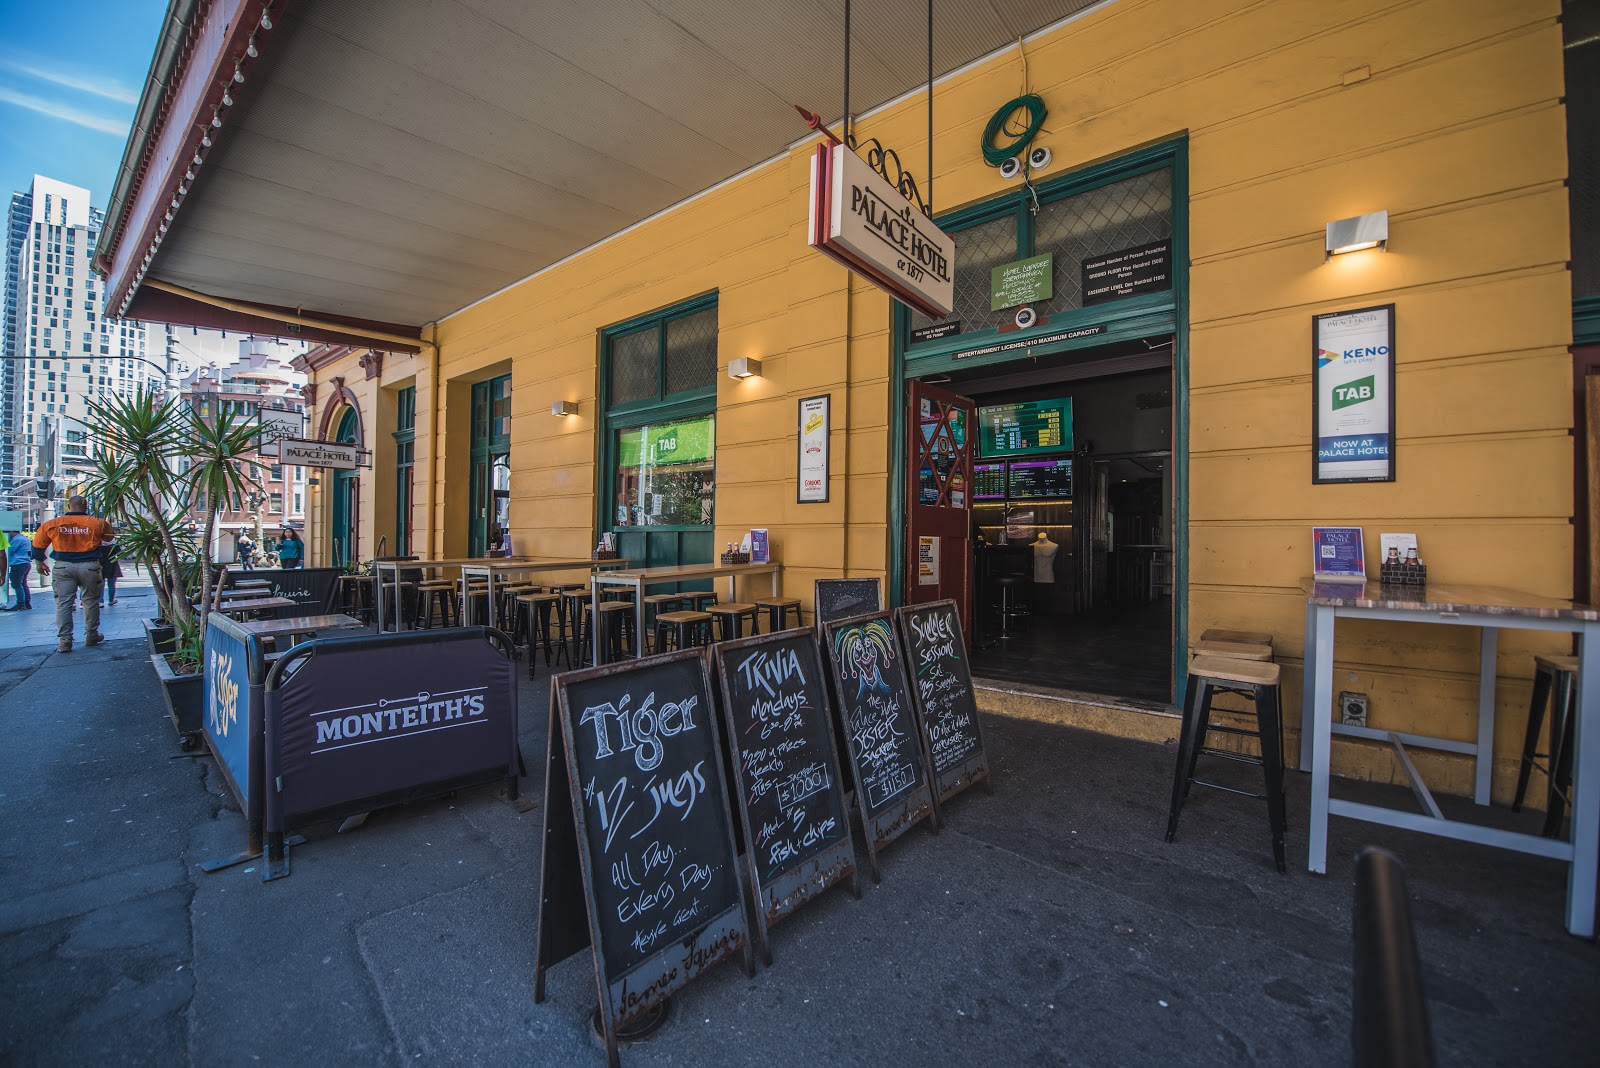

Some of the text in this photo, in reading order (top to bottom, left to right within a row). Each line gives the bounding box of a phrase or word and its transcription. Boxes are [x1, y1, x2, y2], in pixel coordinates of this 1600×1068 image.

[852, 184, 951, 283] PALACE HOTEL
[1086, 261, 1106, 270] Maximum
[1106, 256, 1123, 265] Number
[1145, 246, 1167, 256] Permitted
[907, 261, 924, 283] 1877
[1089, 271, 1107, 280] GROUND
[1107, 267, 1122, 276] FLOOR
[1122, 265, 1132, 273] Five
[1132, 260, 1151, 270] Hundred
[1117, 271, 1132, 279] Person
[1087, 287, 1110, 296] BASEMENT
[1110, 283, 1124, 291] LEVEL
[1134, 277, 1153, 286] Hundred
[957, 346, 1001, 359] ENTERTAINMENT
[1028, 338, 1037, 347] 410
[1038, 334, 1067, 345] MAXIMUM
[1068, 326, 1100, 340] CAPACITY
[1343, 346, 1389, 359] KENO
[1336, 386, 1371, 401] TAB
[658, 437, 677, 451] TAB
[1318, 447, 1389, 458] PALACE HOTEL
[1333, 439, 1374, 449] NOW AT
[287, 449, 353, 462] PALACE HOTEL
[217, 652, 239, 738] Tiger
[866, 692, 883, 710] The
[316, 694, 485, 744] MONTEITH'S
[580, 691, 698, 771] Tiger
[781, 772, 822, 803] $1000
[611, 852, 642, 890] All
[617, 880, 676, 923] Every
